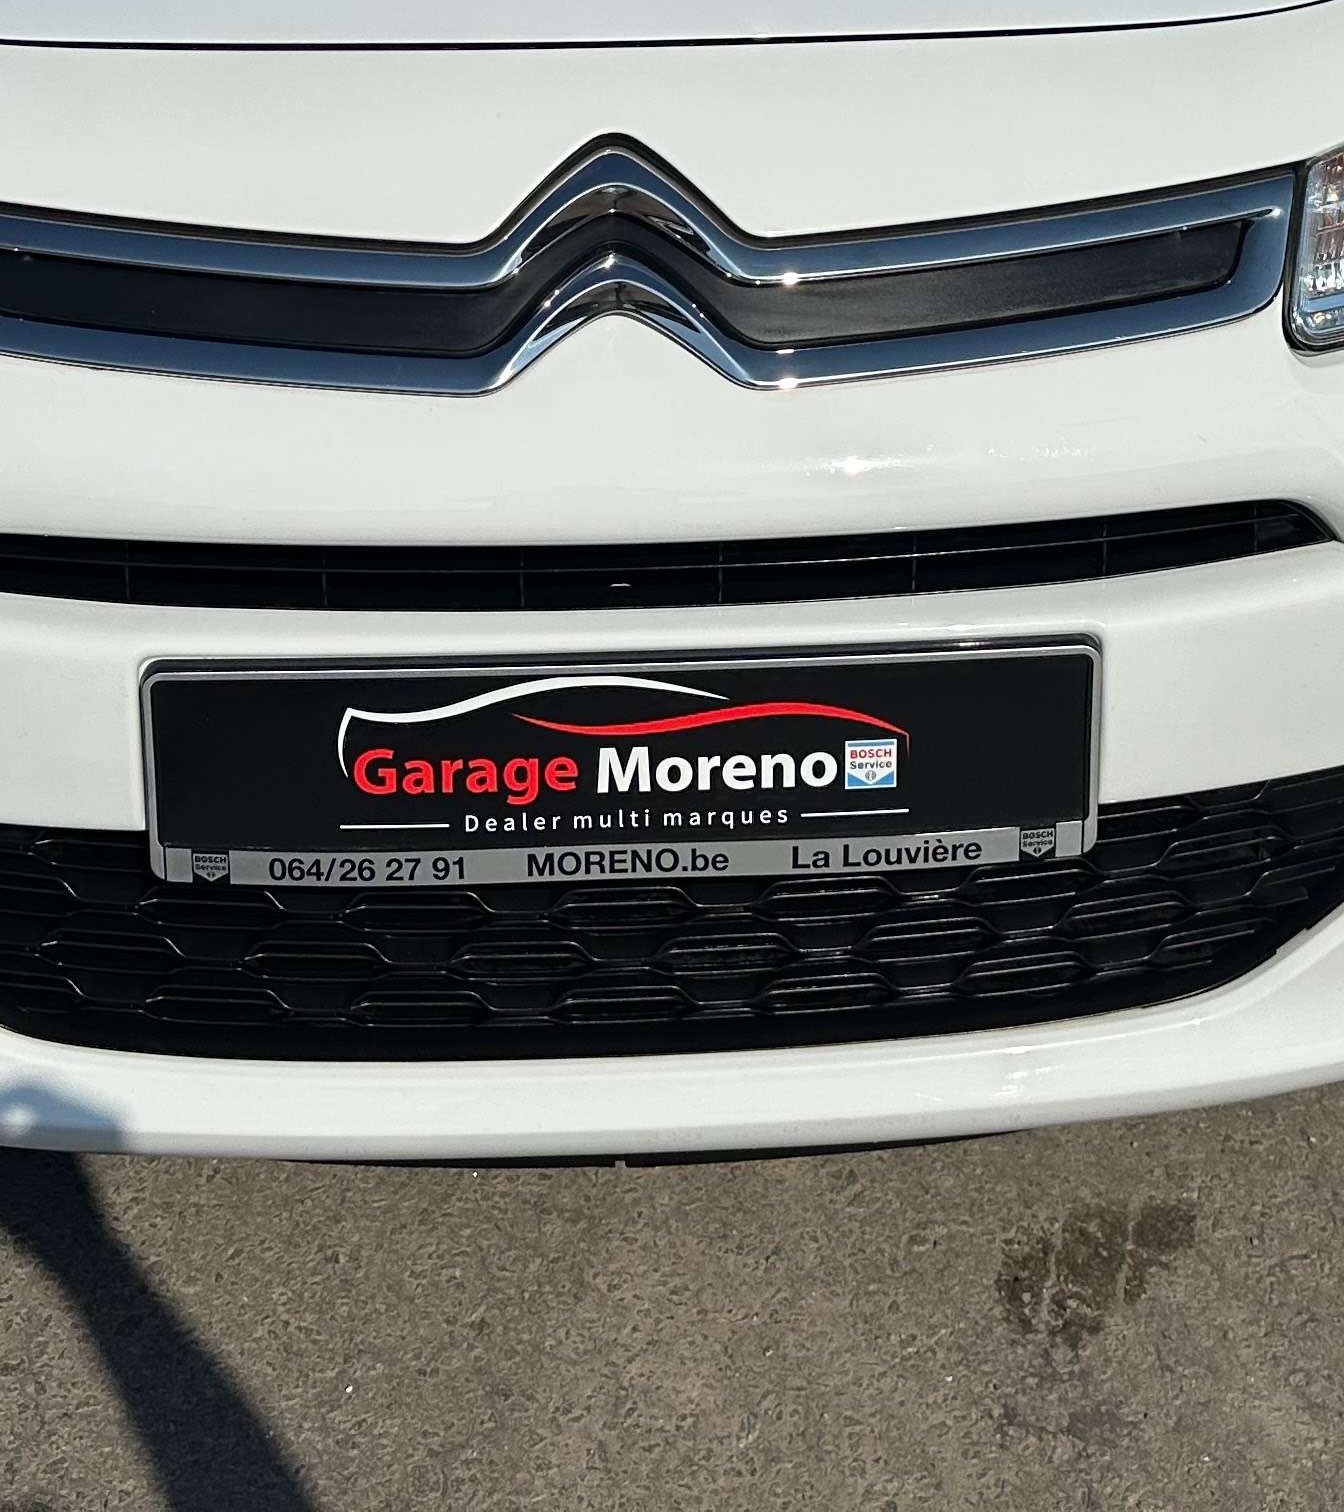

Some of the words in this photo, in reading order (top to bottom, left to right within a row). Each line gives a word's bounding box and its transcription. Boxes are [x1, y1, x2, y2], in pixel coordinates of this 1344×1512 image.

[849, 760, 893, 770] Service
[850, 749, 892, 759] BOSCH
[353, 748, 579, 805] Garage
[597, 746, 838, 794] Moreno
[465, 812, 561, 833] Dealer
[573, 808, 650, 829] multi
[663, 809, 789, 829] marques
[1022, 829, 1054, 839] BOSCH
[194, 855, 227, 864] BOSCH
[527, 848, 730, 876] MORENO.be
[792, 845, 831, 869] La
[842, 838, 983, 867] Louvière
[269, 857, 375, 882] 064/26
[385, 857, 421, 882] 27
[432, 856, 466, 880] 91
